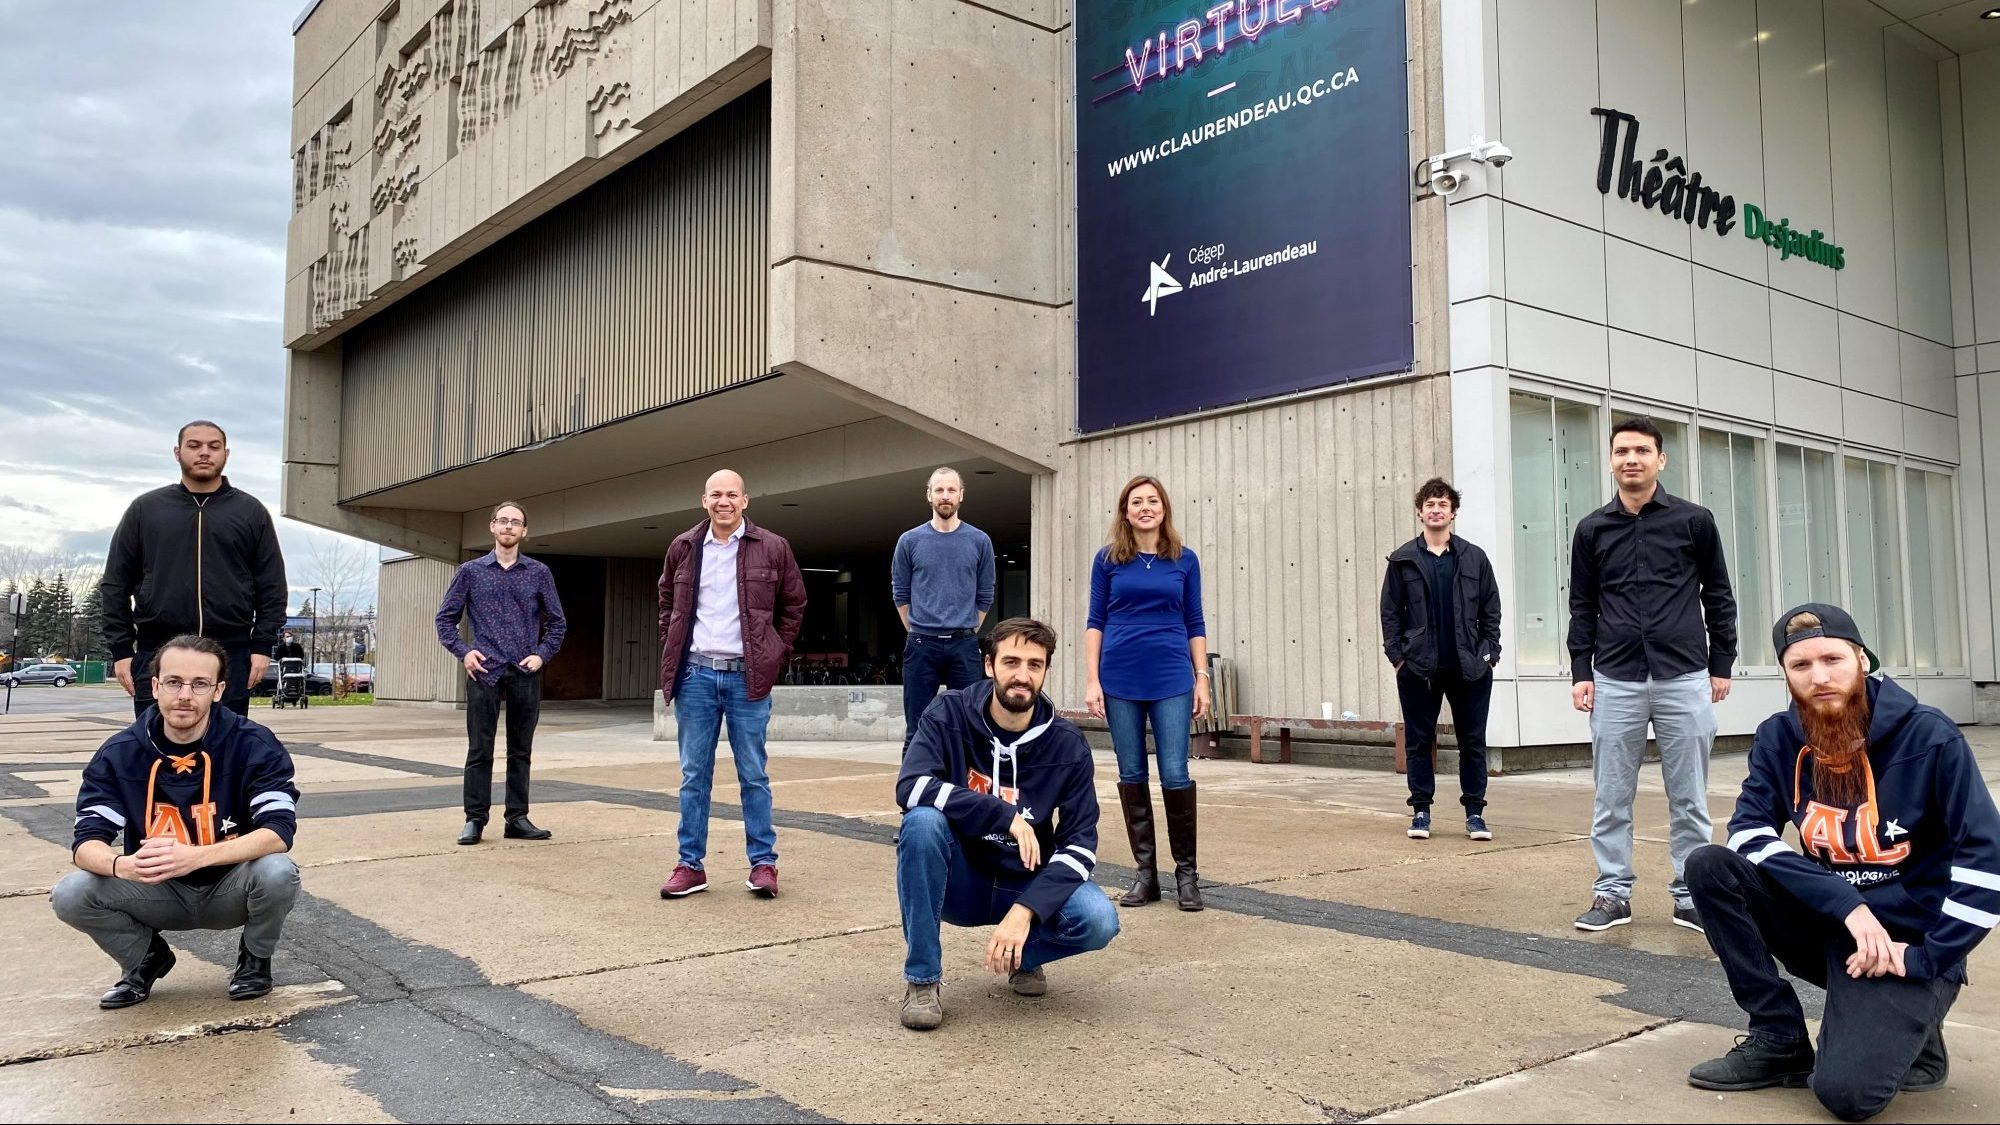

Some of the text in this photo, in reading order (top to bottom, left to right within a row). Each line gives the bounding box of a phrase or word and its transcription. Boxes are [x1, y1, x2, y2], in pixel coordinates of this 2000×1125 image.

[1125, 0, 1340, 89] VIRTU
[1107, 67, 1359, 177] WWW.CLAURENDEAU.QC.CA
[1590, 107, 1845, 271] Théâtre Desjardins
[1188, 242, 1225, 265] Cégep
[1188, 240, 1317, 289] André-Laurendeau
[1800, 800, 1912, 866] AL
